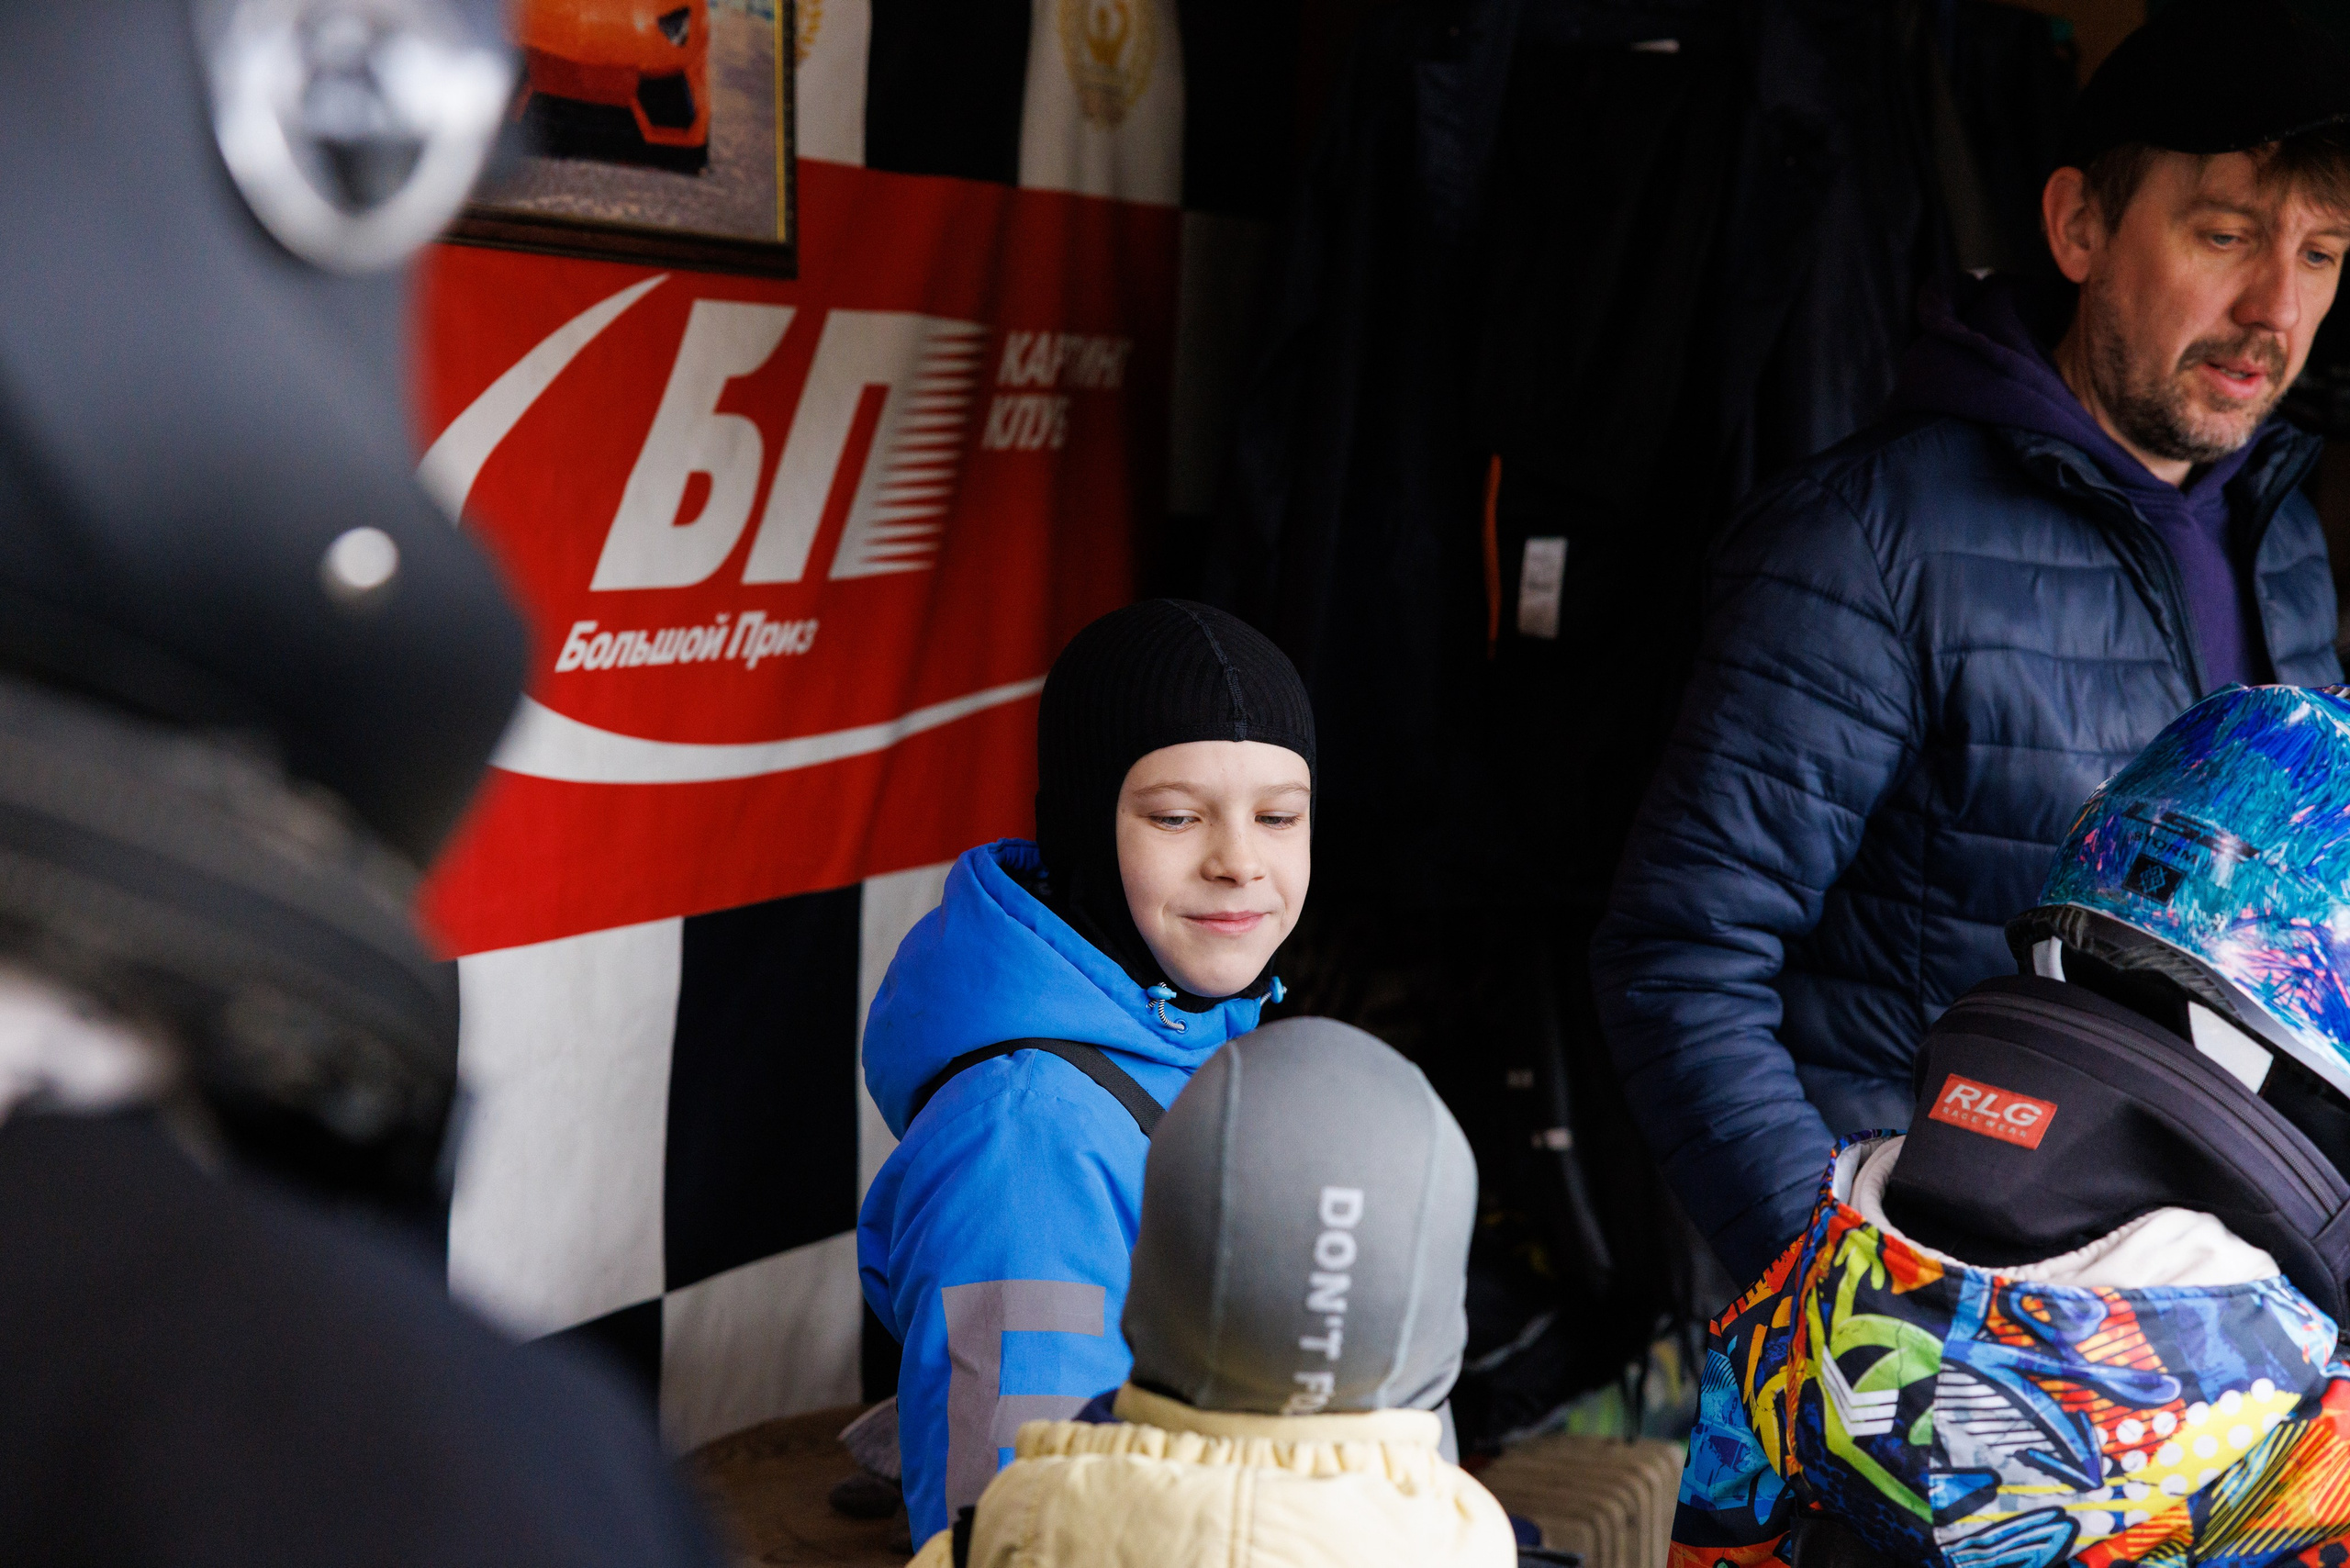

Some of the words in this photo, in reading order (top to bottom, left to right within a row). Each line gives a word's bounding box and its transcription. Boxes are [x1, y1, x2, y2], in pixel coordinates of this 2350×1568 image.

[589, 299, 989, 591] БП
[981, 394, 1072, 451] КЛУБ
[554, 611, 731, 673] Большой
[725, 610, 820, 670] Приз
[1942, 1106, 1979, 1123] RACE
[1986, 1119, 2028, 1138] WEAR
[1944, 1083, 2042, 1126] RLG
[1298, 1186, 1364, 1361] DON'T
